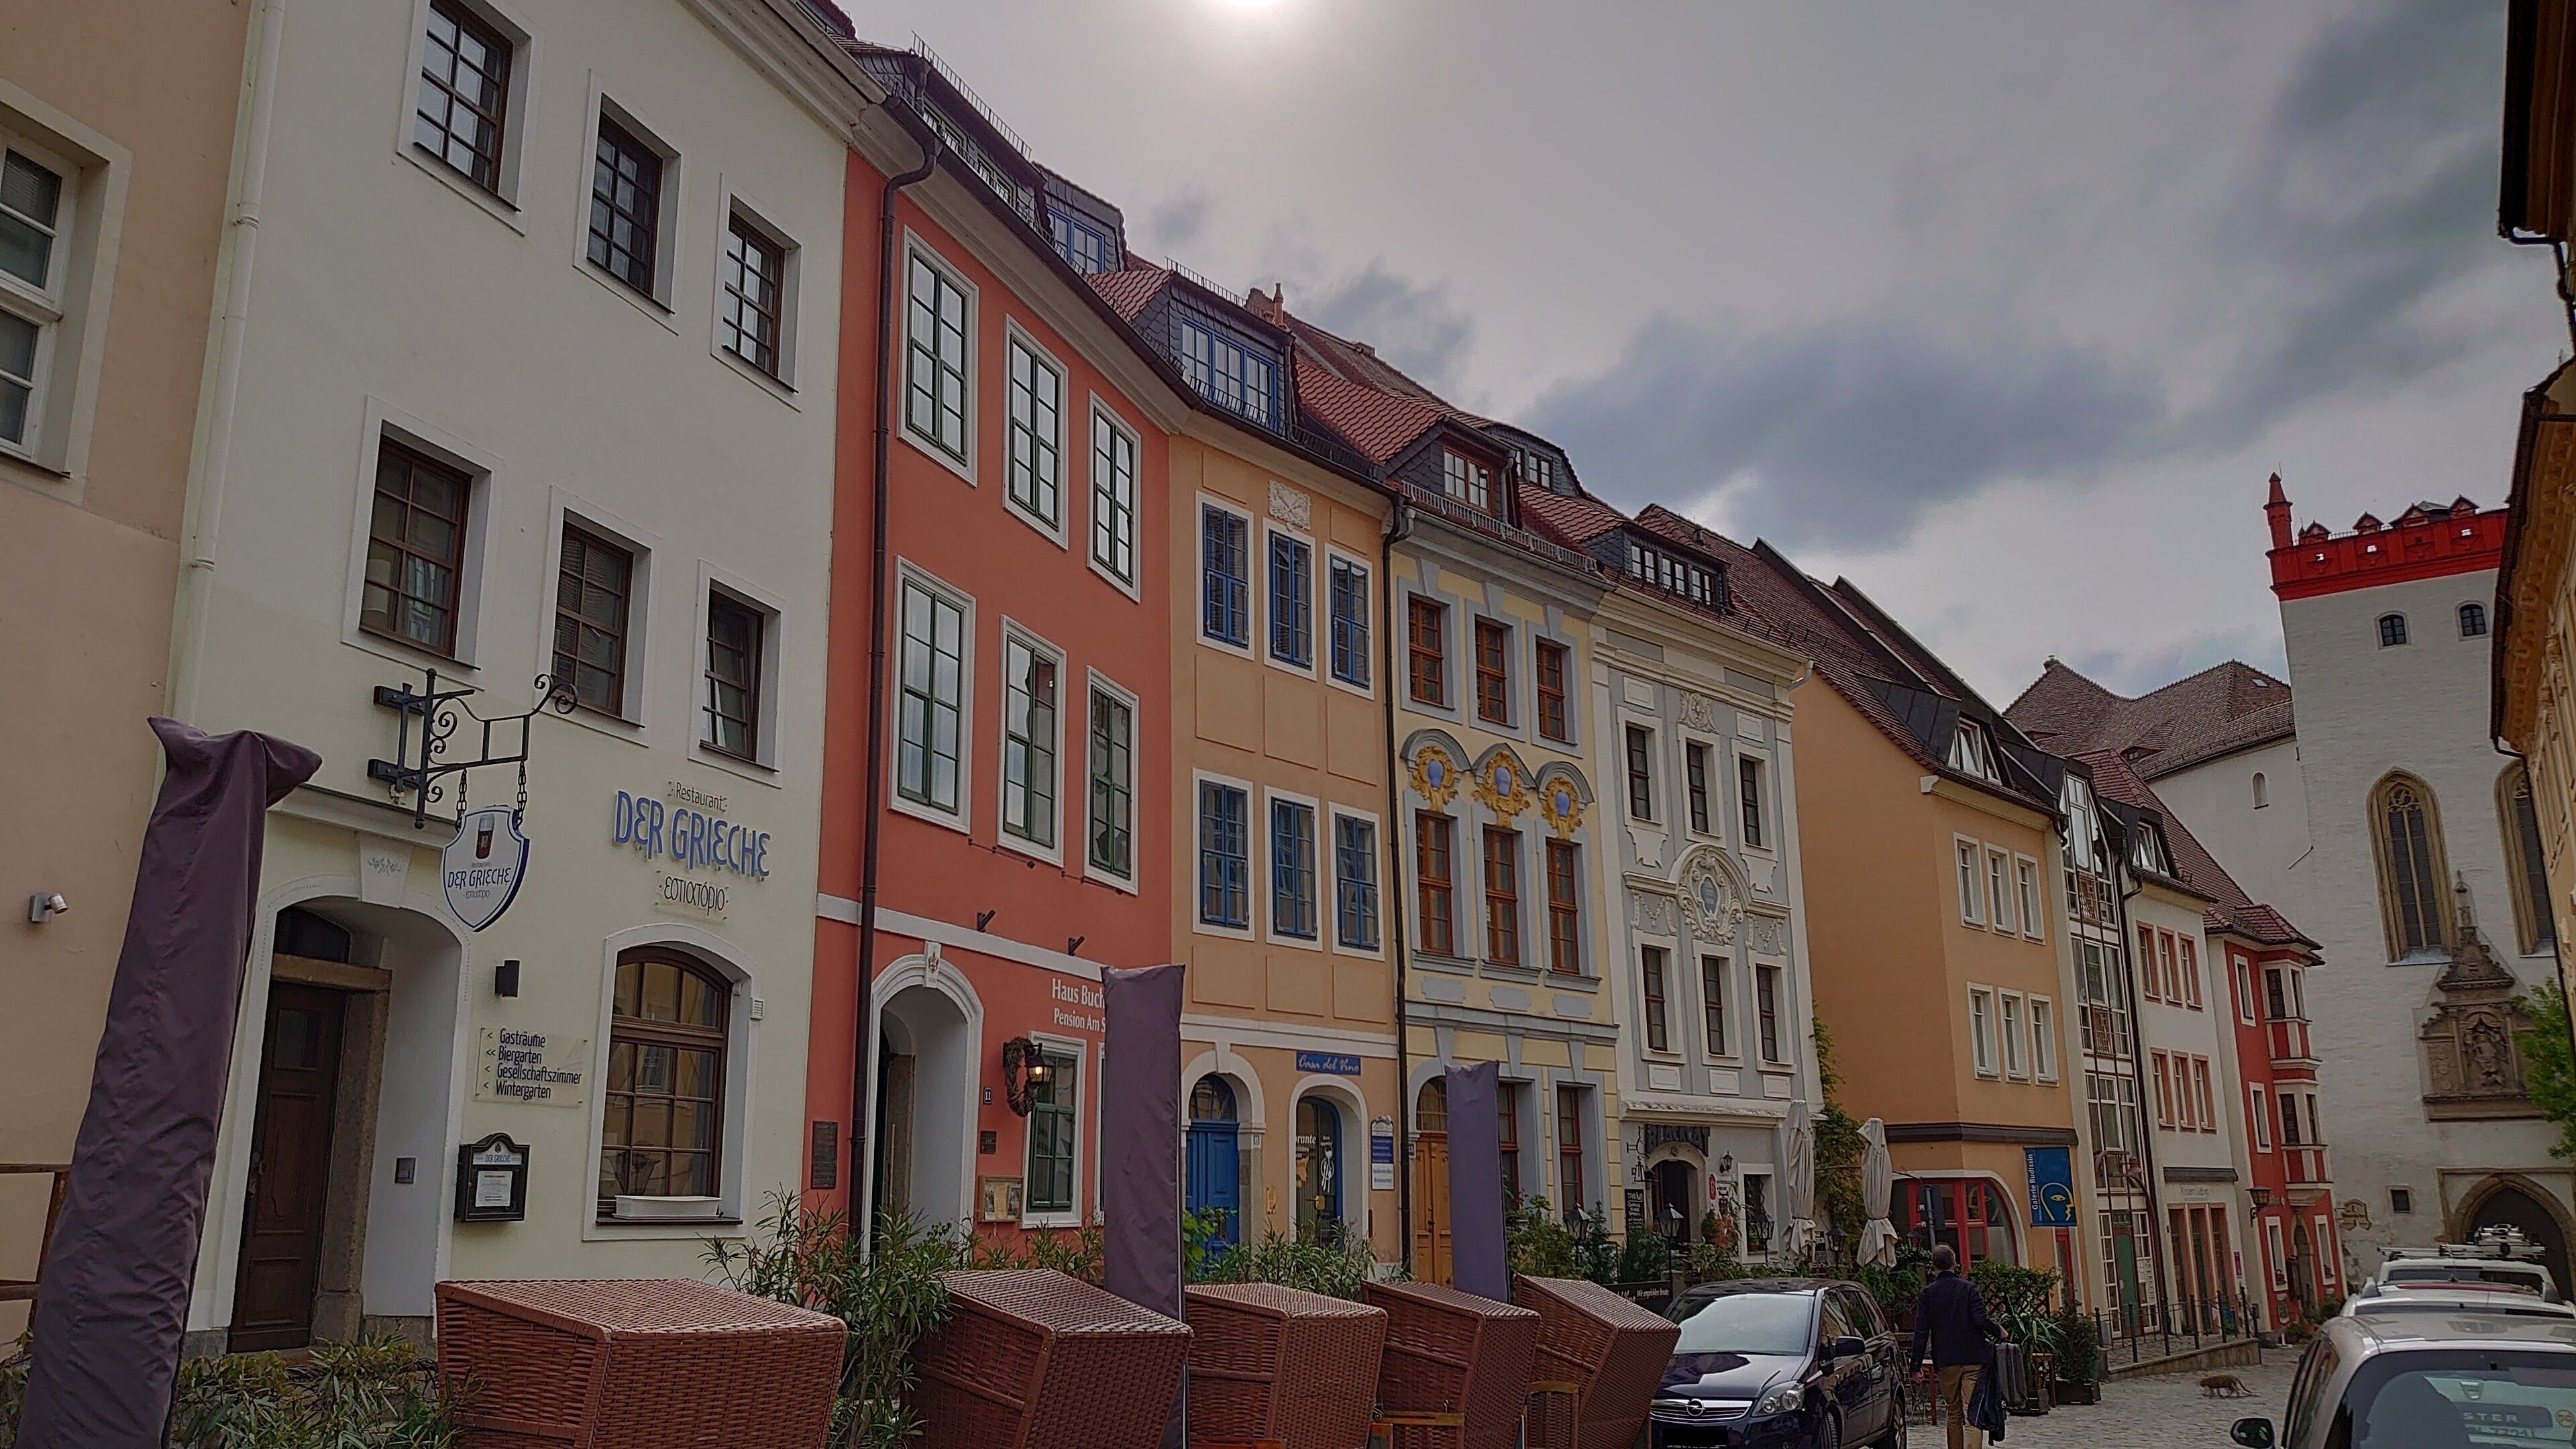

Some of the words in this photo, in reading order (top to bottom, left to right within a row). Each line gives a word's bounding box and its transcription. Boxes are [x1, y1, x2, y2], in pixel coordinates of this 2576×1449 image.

[676, 782, 724, 811] Restaurant
[614, 790, 665, 859] DER
[671, 808, 771, 877] GRIECHE
[447, 871, 467, 890] DER
[469, 867, 511, 889] GRIECHE
[1051, 977, 1079, 1004] Haus
[1054, 1008, 1085, 1029] Pension
[1086, 1014, 1100, 1032] Am
[1101, 1016, 1106, 1033] S
[499, 1028, 545, 1047] Gasträume
[498, 1046, 542, 1064] Biergarten
[1322, 1057, 1338, 1070] del
[1340, 1058, 1360, 1072] Vino
[497, 1062, 582, 1085] Gesellschaftszimmer
[496, 1079, 551, 1100] Wintergarten
[985, 1090, 991, 1101] 11
[1296, 1134, 1316, 1144] rante
[2027, 1154, 2035, 1183] Budissin
[2030, 1185, 2038, 1210] Galerie
[2463, 1411, 2518, 1422] STER
